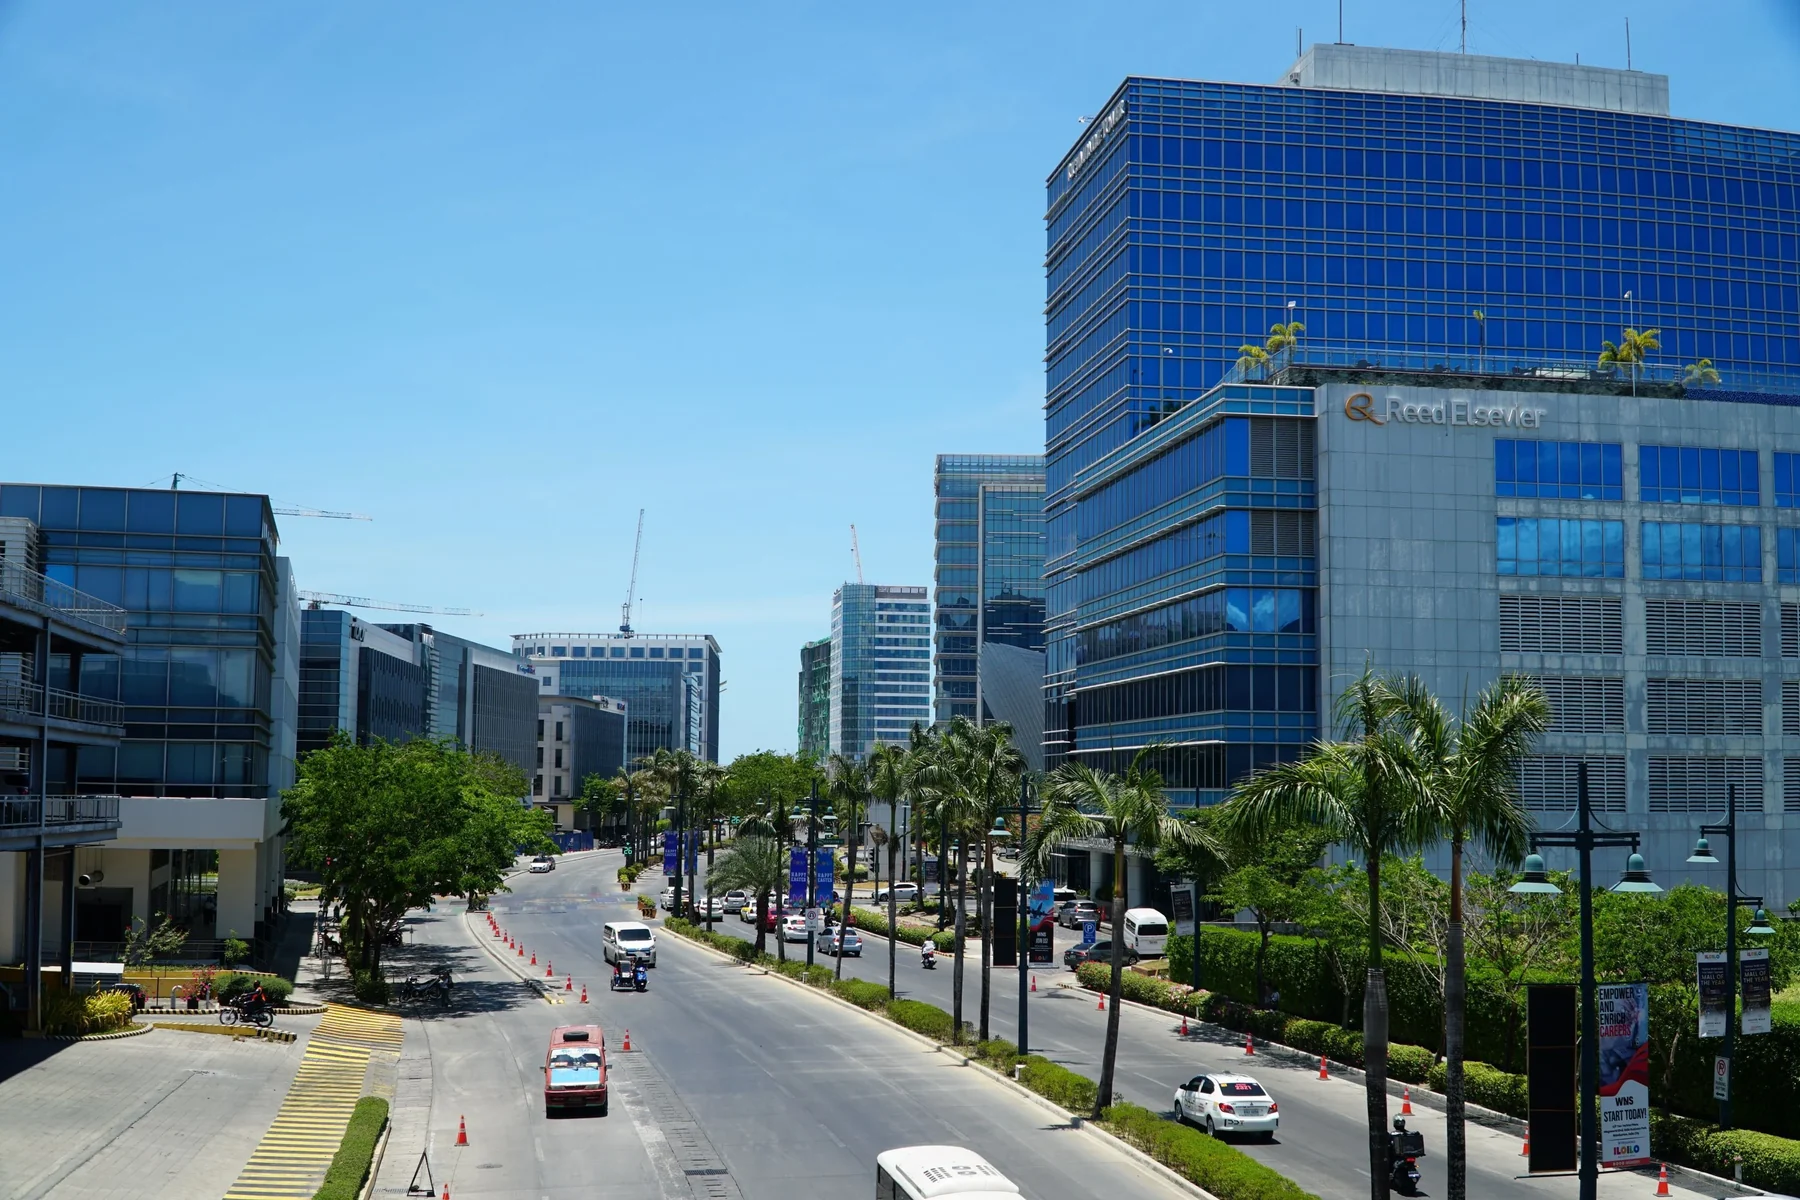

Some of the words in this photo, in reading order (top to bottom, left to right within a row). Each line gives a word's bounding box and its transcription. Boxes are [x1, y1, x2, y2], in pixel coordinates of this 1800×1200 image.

[1385, 396, 1446, 425] Reed
[1451, 400, 1547, 429] Elsevier
[1600, 987, 1634, 1000] EMPOWER
[1600, 1001, 1614, 1012] AND
[1600, 1012, 1626, 1025] ENRICH
[1600, 1024, 1631, 1037] CAREERS
[1615, 1096, 1634, 1106] WNS
[1603, 1110, 1623, 1122] START
[1625, 1108, 1647, 1120] TODAY!
[1613, 1144, 1640, 1155] ILOILO
